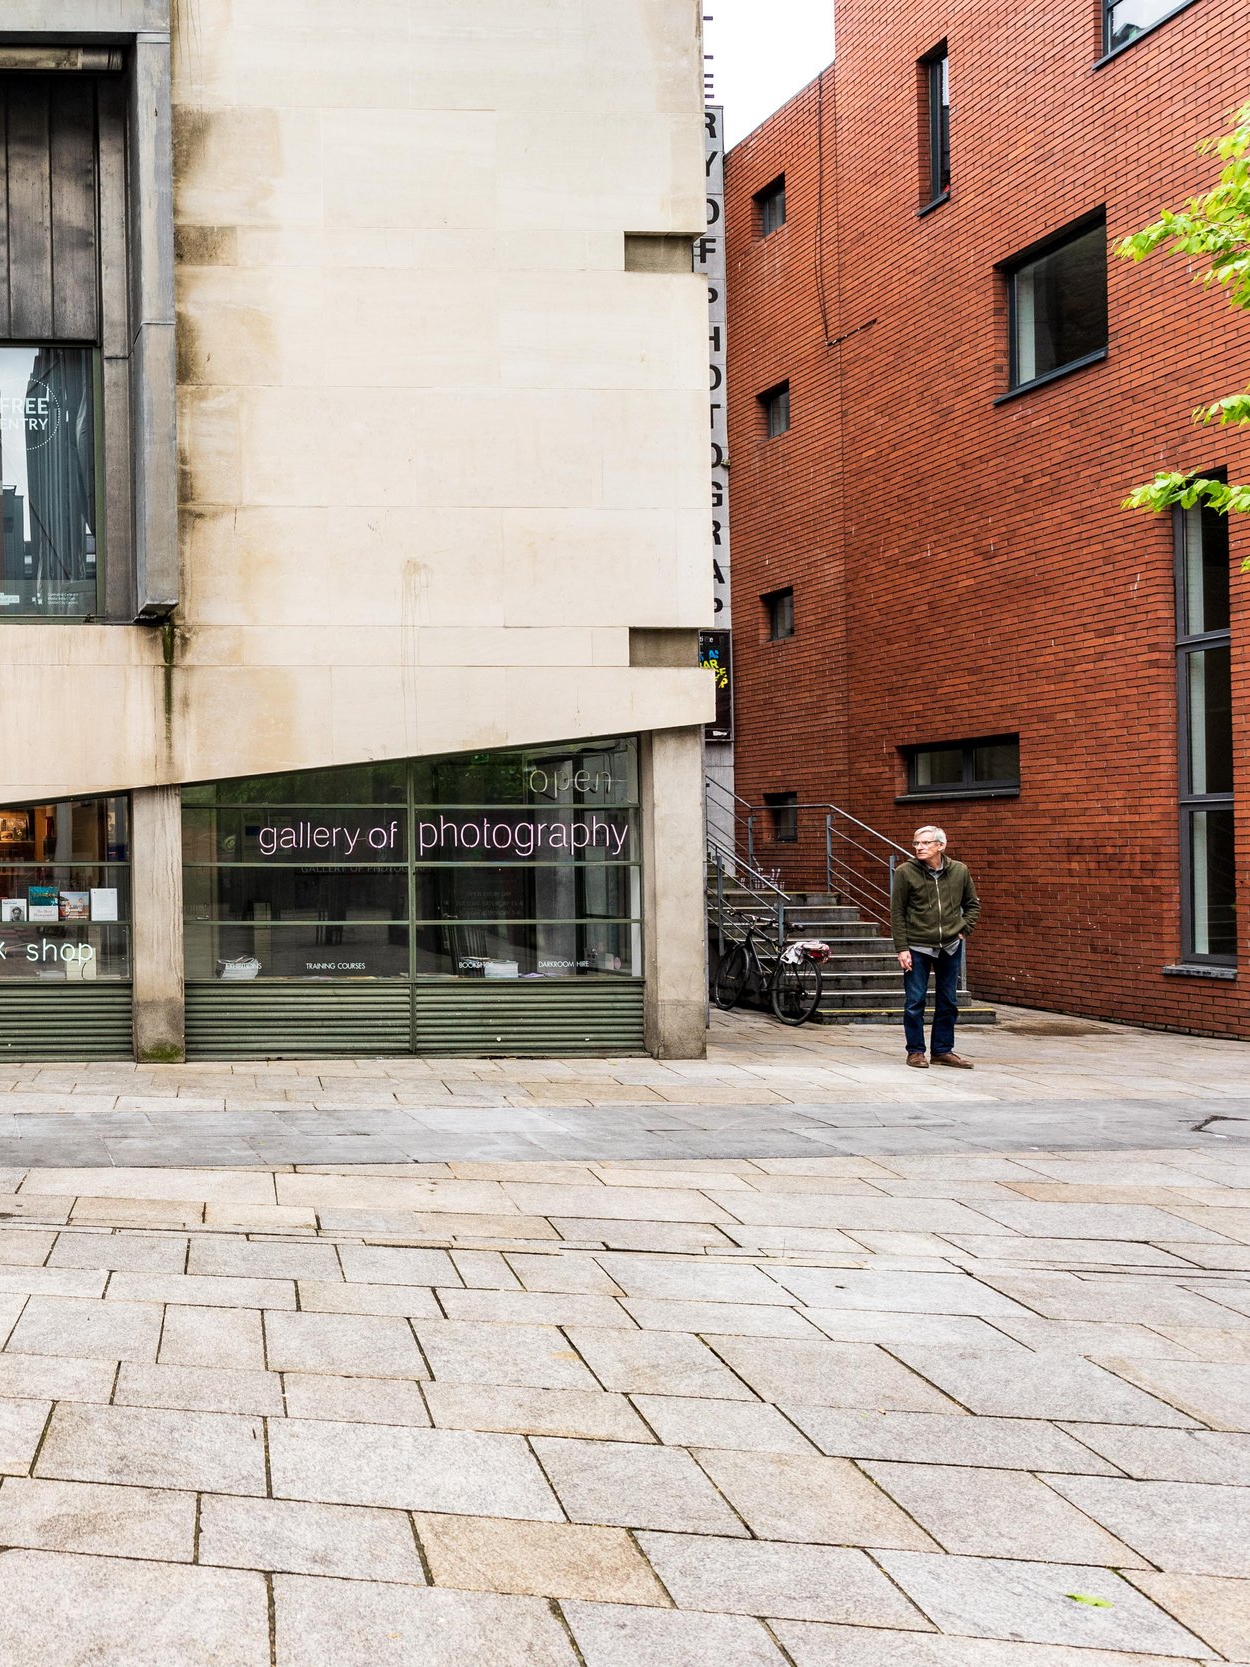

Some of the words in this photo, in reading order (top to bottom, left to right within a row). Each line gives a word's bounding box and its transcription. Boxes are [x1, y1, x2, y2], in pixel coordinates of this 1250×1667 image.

[0, 398, 48, 414] FREE
[0, 418, 48, 430] ENTRY
[529, 769, 611, 799] open
[259, 822, 360, 855] gallery
[368, 821, 398, 849] of
[419, 815, 628, 856] photography
[26, 938, 93, 966] shop
[306, 962, 336, 970] TRAINING
[337, 962, 365, 970] COURSES
[538, 960, 574, 968] DARKROOM
[576, 960, 589, 968] HIRE
